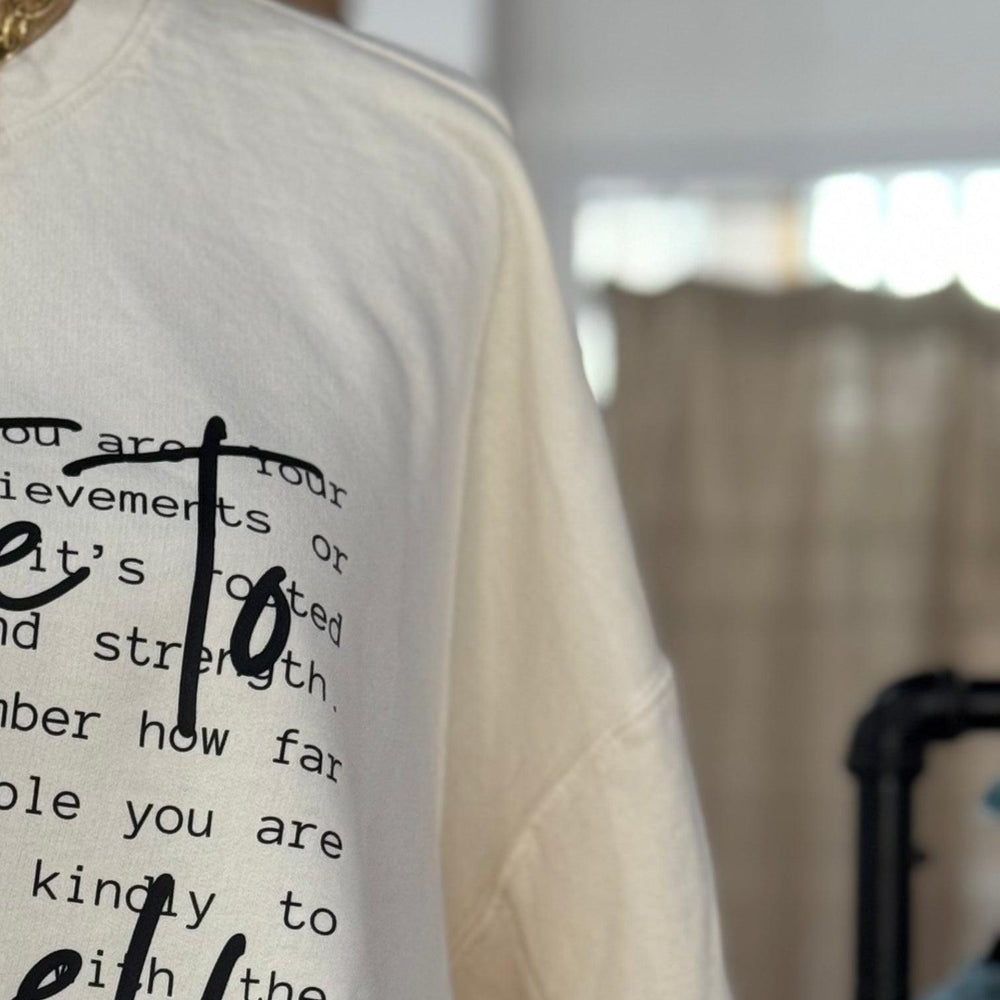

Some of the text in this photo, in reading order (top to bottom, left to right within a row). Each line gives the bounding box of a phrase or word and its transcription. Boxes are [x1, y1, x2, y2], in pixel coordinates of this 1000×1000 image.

[62, 416, 324, 738] To
[312, 535, 348, 575] or
[208, 569, 342, 648] oted
[139, 710, 230, 756] how
[272, 729, 342, 783] far
[123, 800, 213, 839] you
[256, 816, 343, 859] are
[32, 859, 216, 930] kindly
[280, 890, 337, 936] to
